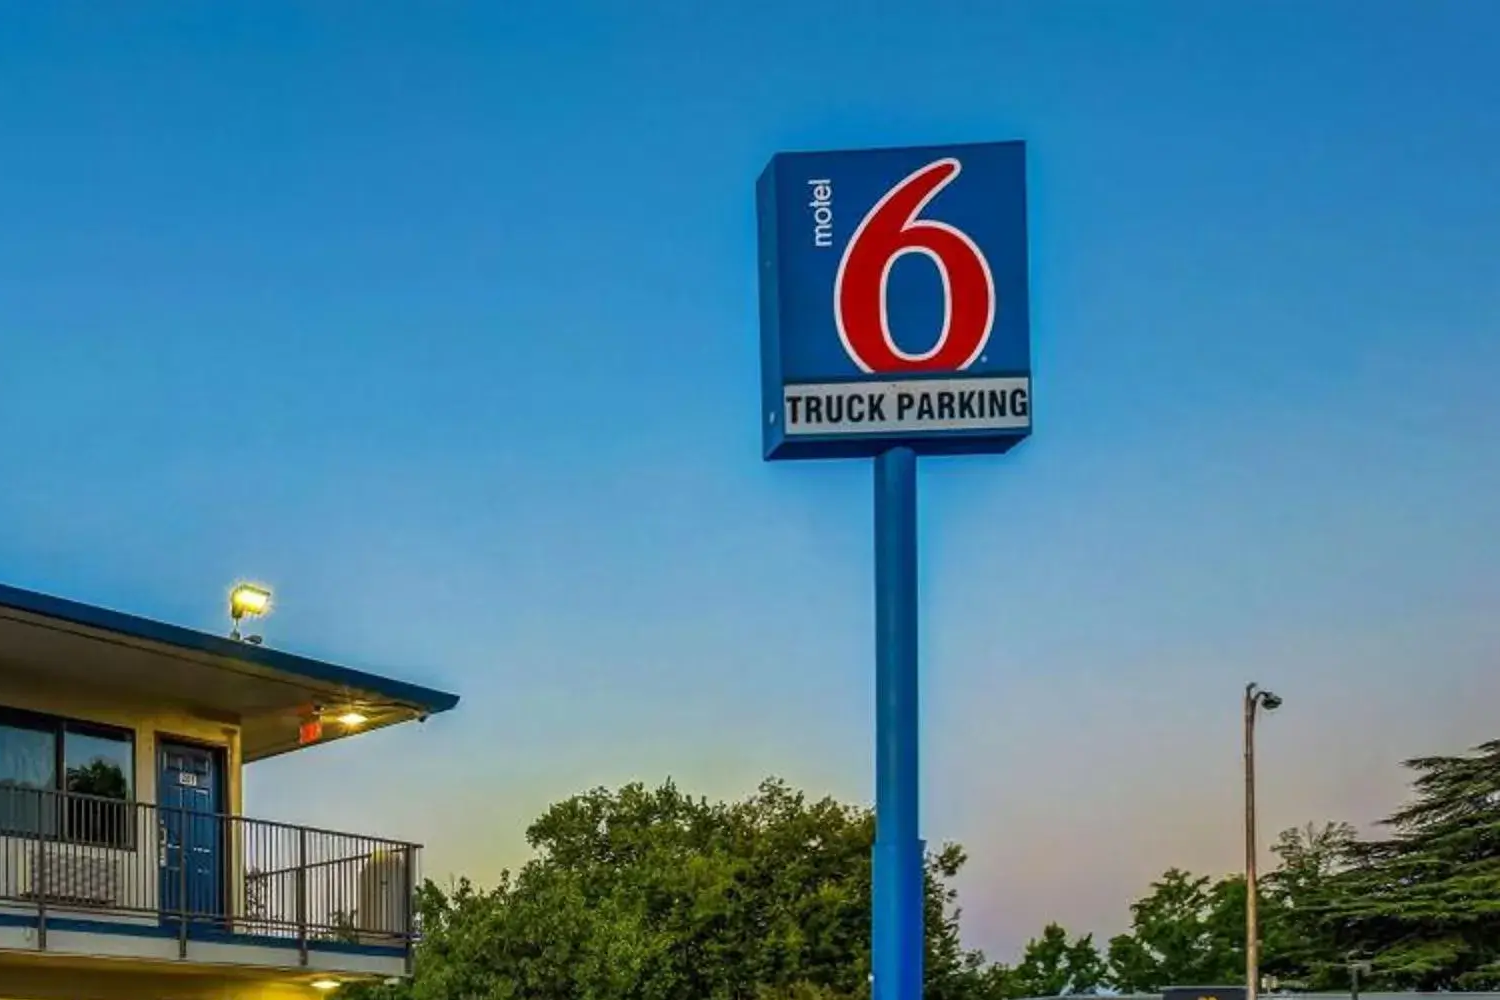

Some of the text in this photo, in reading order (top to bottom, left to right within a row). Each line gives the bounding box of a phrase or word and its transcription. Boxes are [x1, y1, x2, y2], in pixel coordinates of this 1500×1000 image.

[808, 179, 833, 247] motel
[833, 157, 996, 374] 6
[786, 387, 1028, 425] TRUCK PARKING
